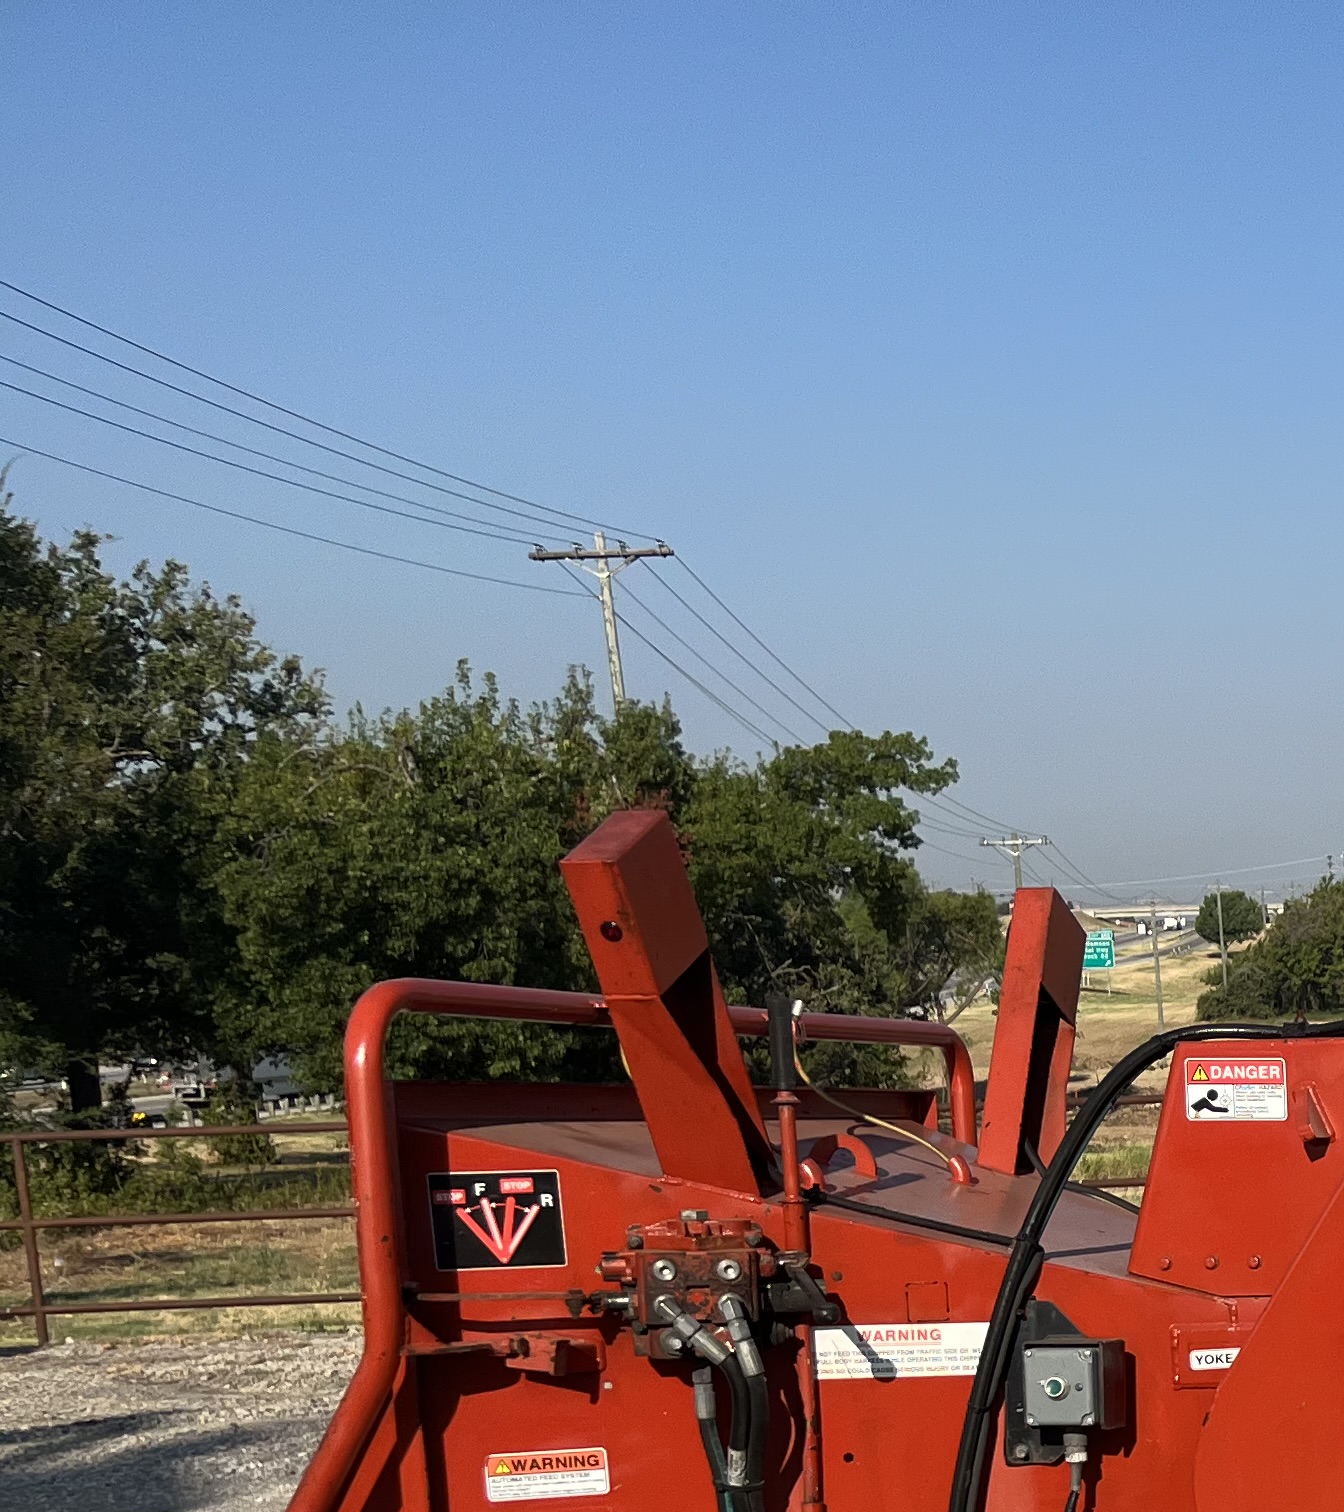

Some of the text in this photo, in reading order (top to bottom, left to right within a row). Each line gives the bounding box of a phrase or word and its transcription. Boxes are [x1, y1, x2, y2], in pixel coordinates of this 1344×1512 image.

[1209, 1065, 1280, 1080] DANGER
[474, 1181, 531, 1197] F STOP
[435, 1192, 554, 1207] STOP R
[861, 1329, 942, 1342] WARNING
[1195, 1353, 1233, 1365] YOKE
[510, 1454, 600, 1472] WARNING
